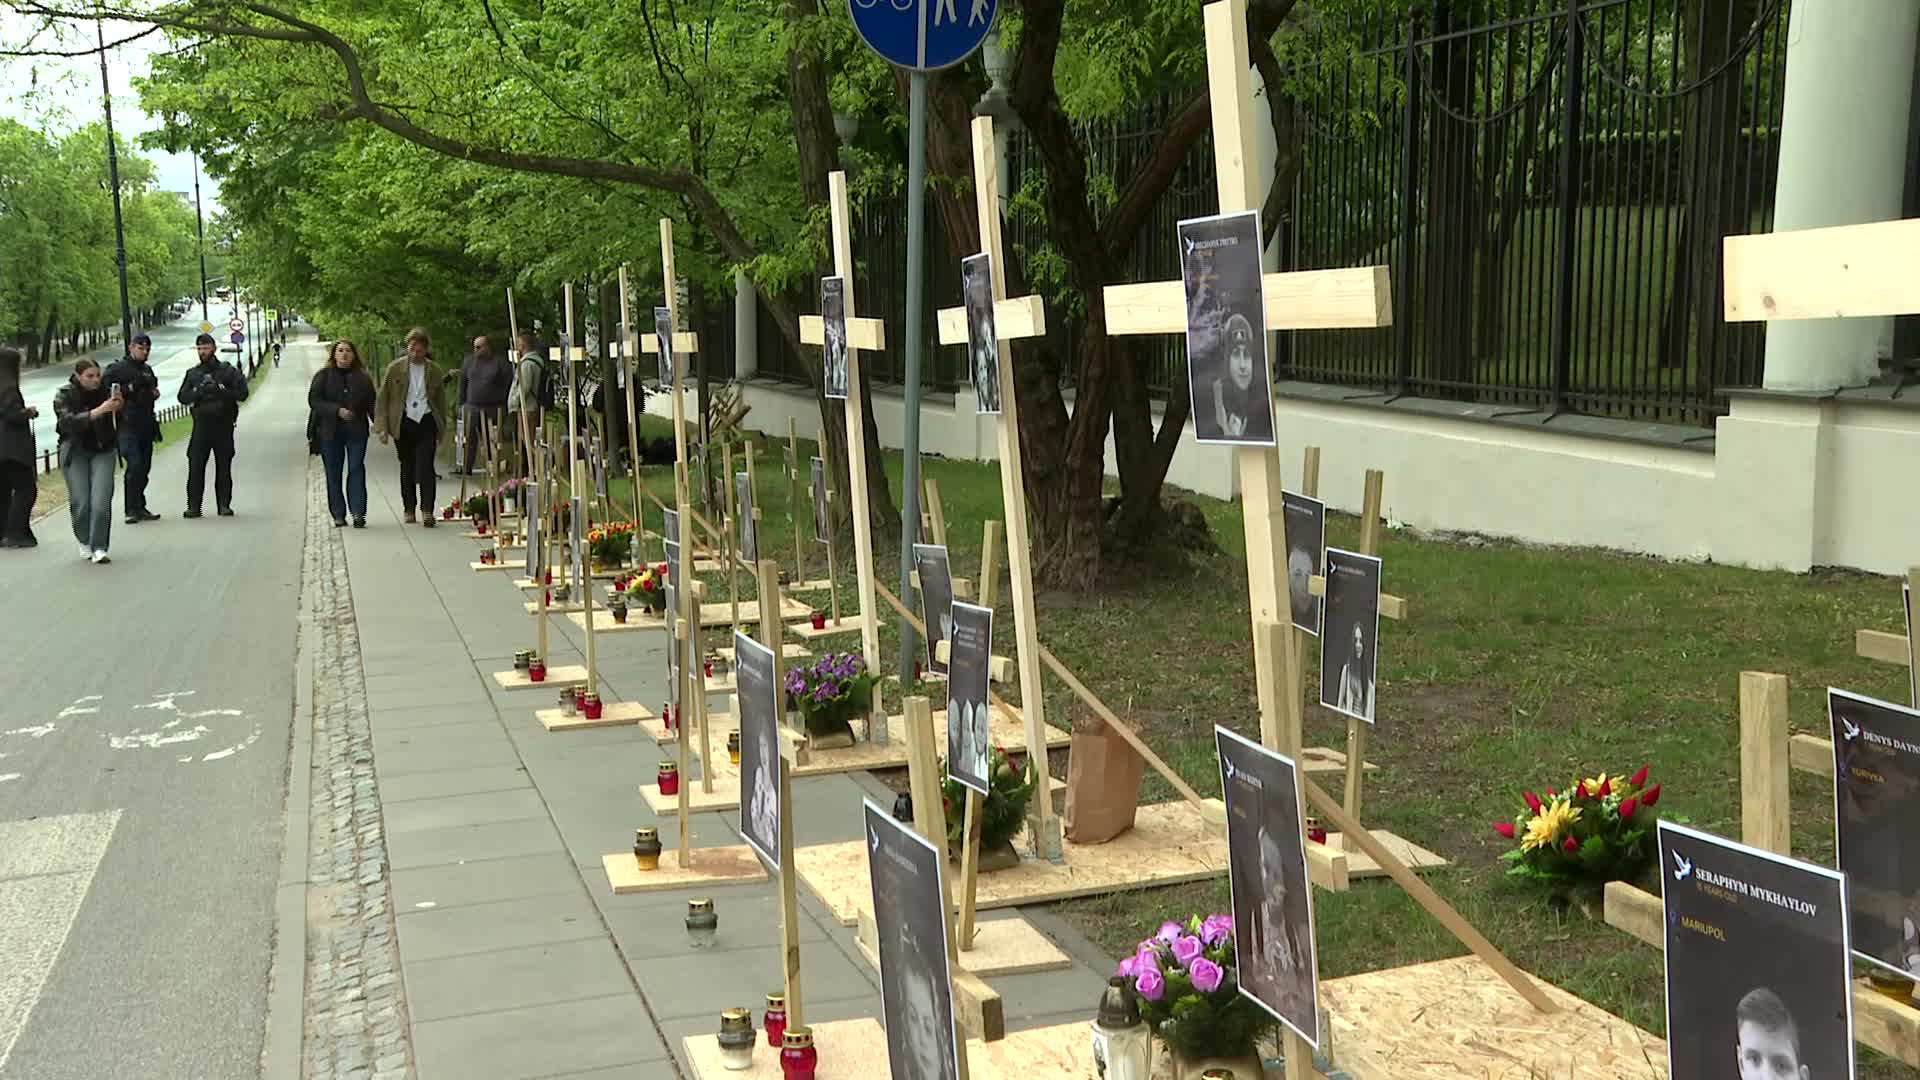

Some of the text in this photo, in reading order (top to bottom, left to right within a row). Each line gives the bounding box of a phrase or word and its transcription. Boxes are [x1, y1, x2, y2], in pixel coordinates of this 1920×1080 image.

[1863, 731, 1892, 747] DENYS
[1695, 867, 1818, 918] SERAPHYM MYKHAYLOV
[1681, 916, 1727, 942] MARIUPOL
